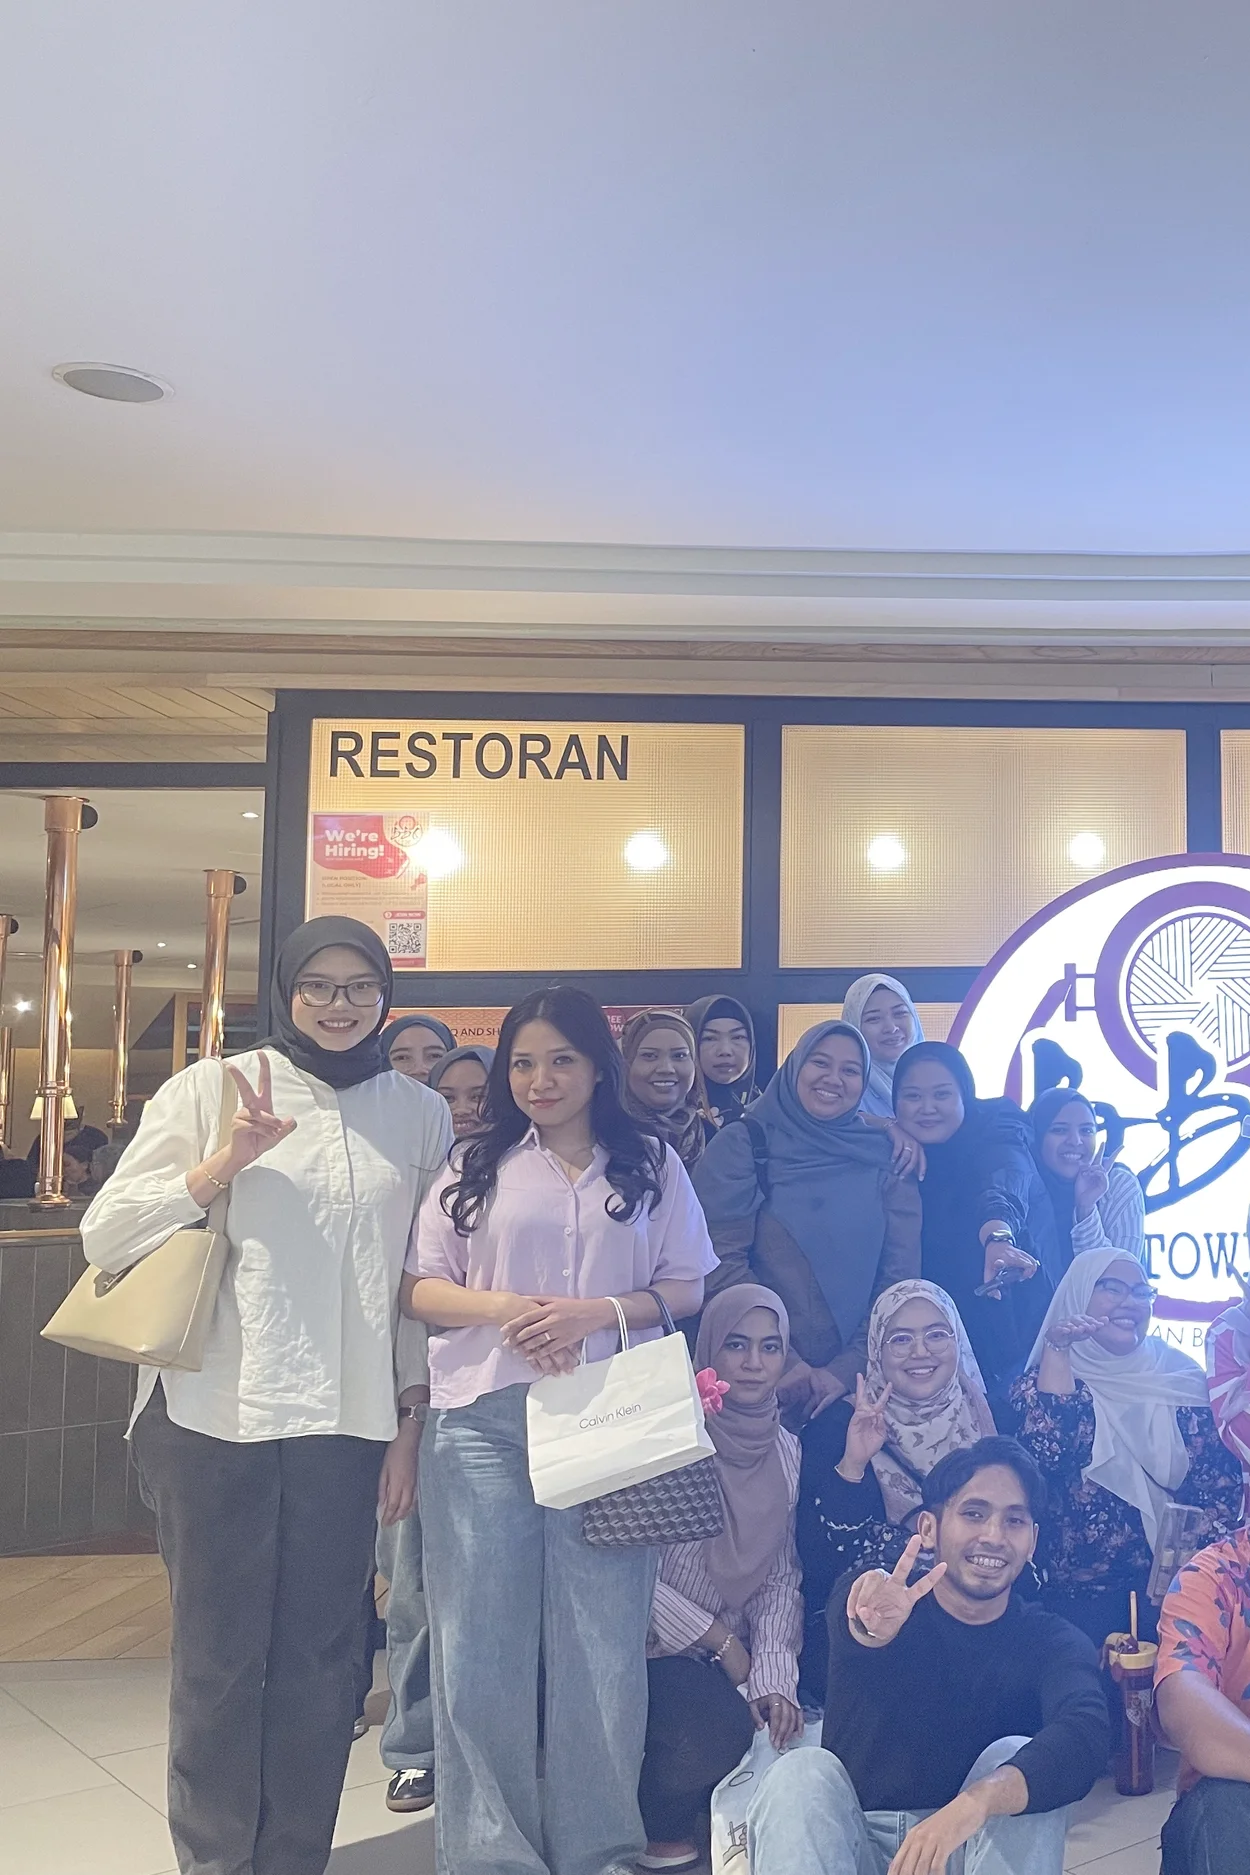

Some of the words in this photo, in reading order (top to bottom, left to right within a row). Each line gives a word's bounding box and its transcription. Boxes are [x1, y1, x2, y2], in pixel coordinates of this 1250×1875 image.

[329, 730, 629, 781] RESTORAN
[324, 829, 379, 842] We're
[325, 843, 385, 860] Hiring!
[461, 1028, 484, 1036] AND
[486, 1028, 500, 1036] SH
[1144, 1231, 1249, 1280] TOW
[579, 1413, 614, 1429] Calvin
[615, 1404, 642, 1419] Klein
